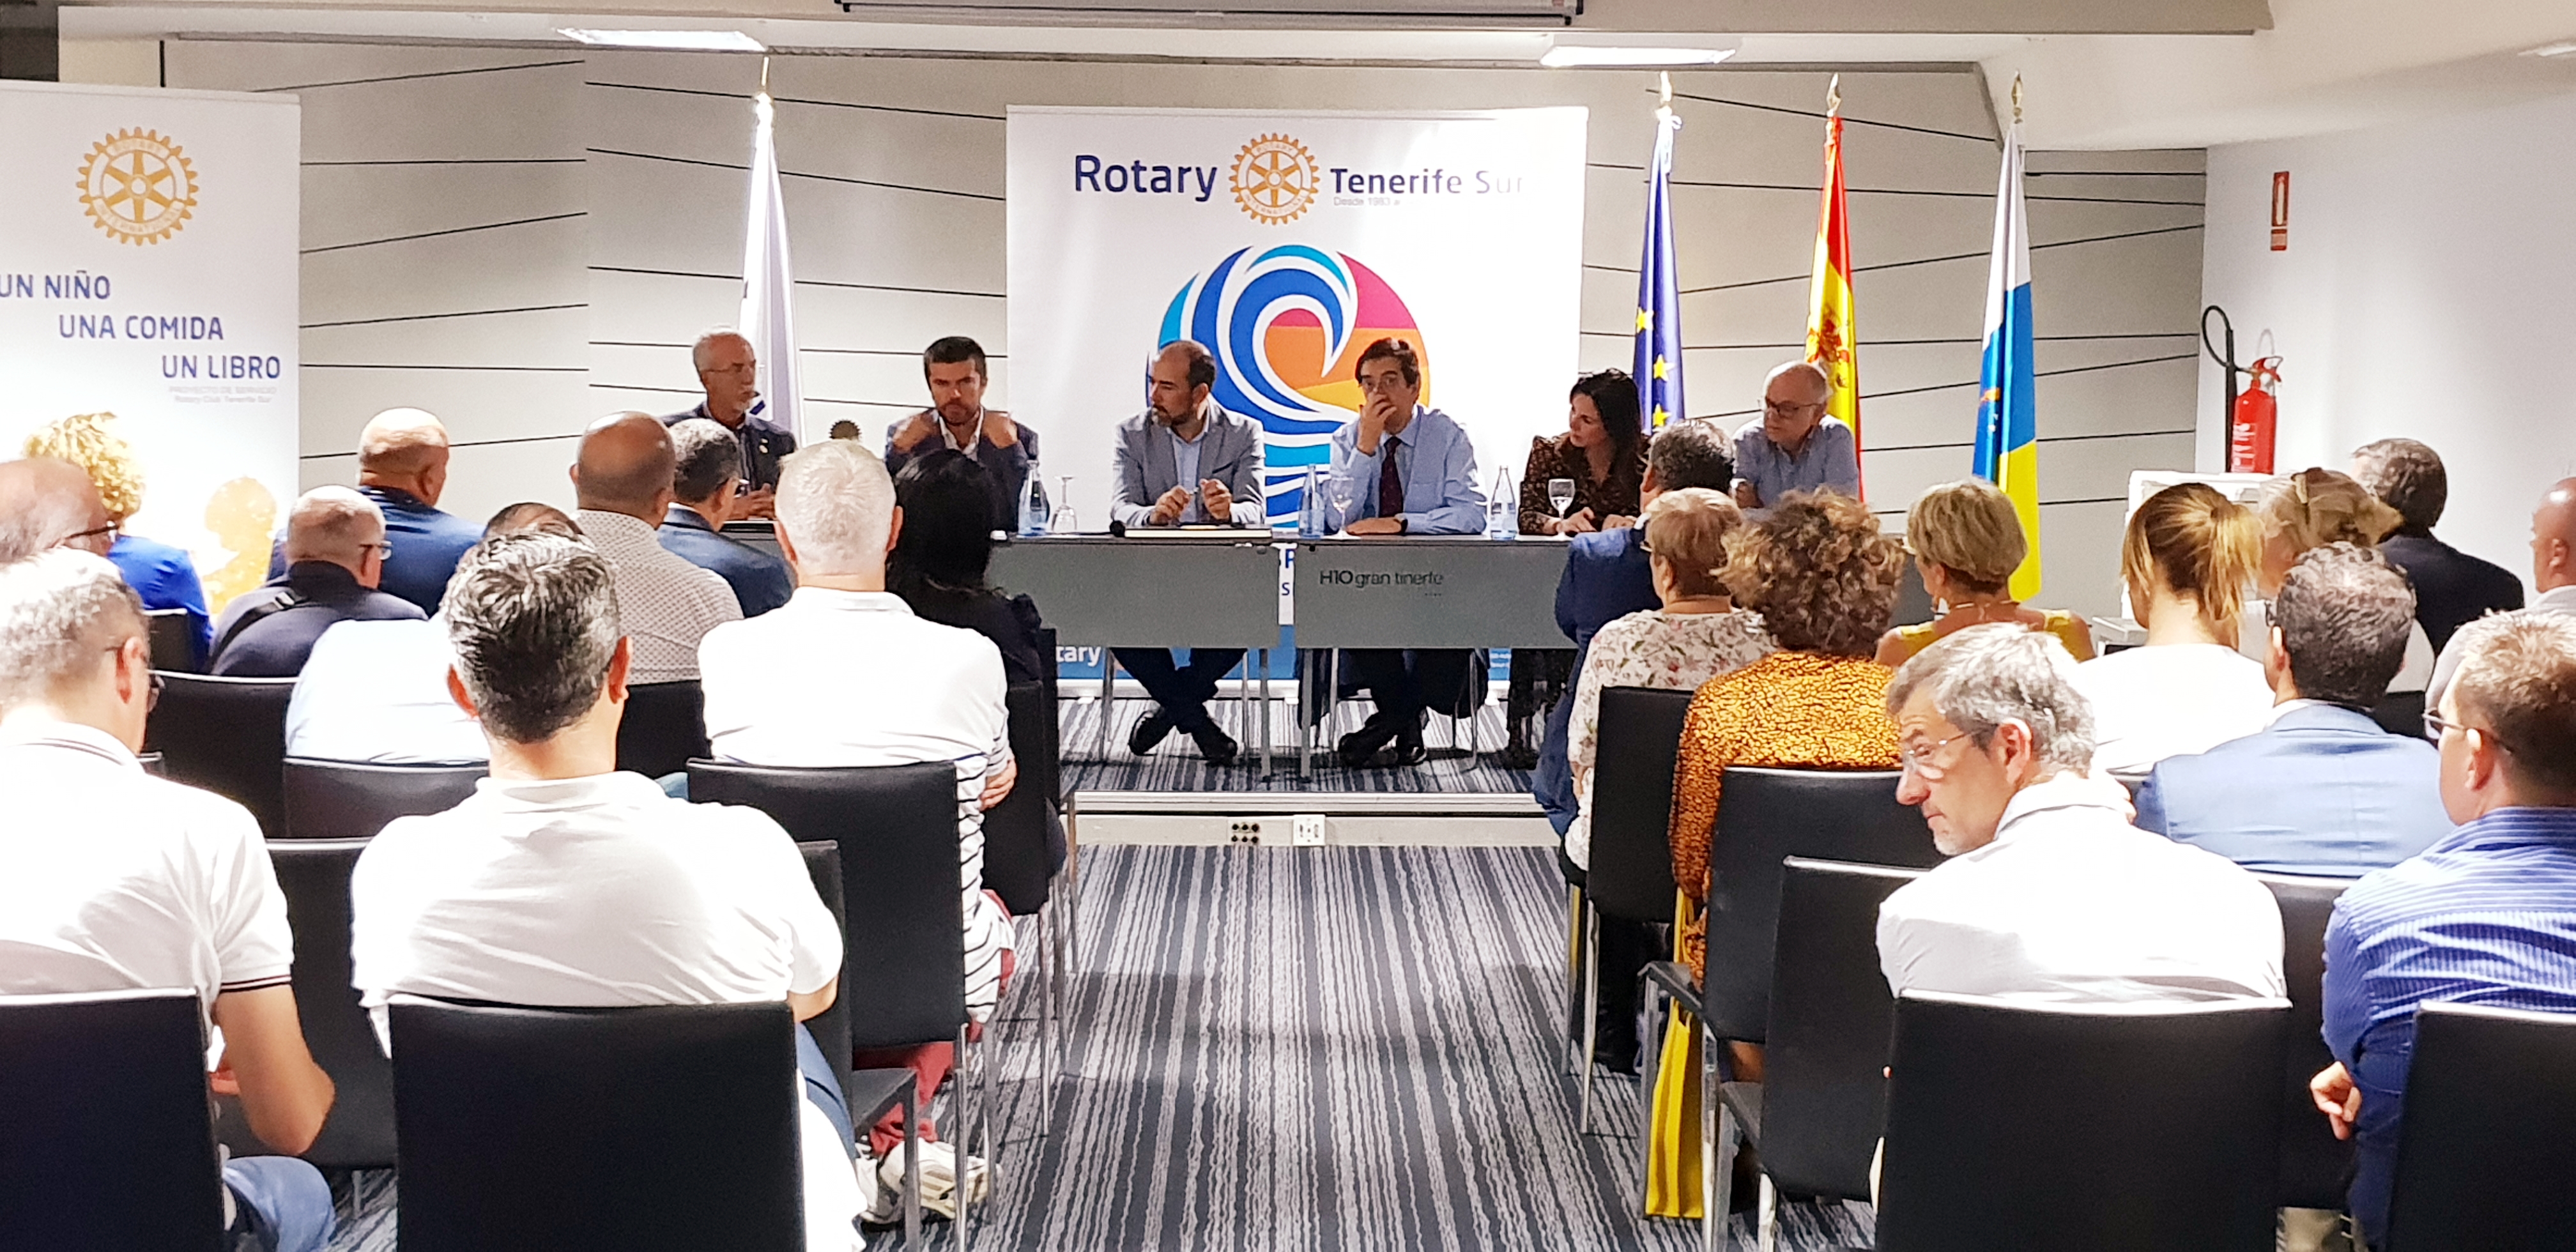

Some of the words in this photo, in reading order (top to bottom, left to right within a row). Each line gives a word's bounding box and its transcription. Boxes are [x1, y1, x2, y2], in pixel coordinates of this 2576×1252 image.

[1075, 155, 1218, 202] Rotary
[1330, 168, 1462, 194] Tenerife
[1475, 169, 1522, 194] Sur
[0, 274, 33, 298] UN
[45, 270, 111, 300] NIÑO
[59, 314, 116, 339] UNA
[125, 316, 224, 340] COMIDA
[162, 355, 197, 379] UN
[208, 355, 281, 379] LIBRO
[1354, 574, 1390, 588] gran
[1055, 646, 1101, 667] tary
